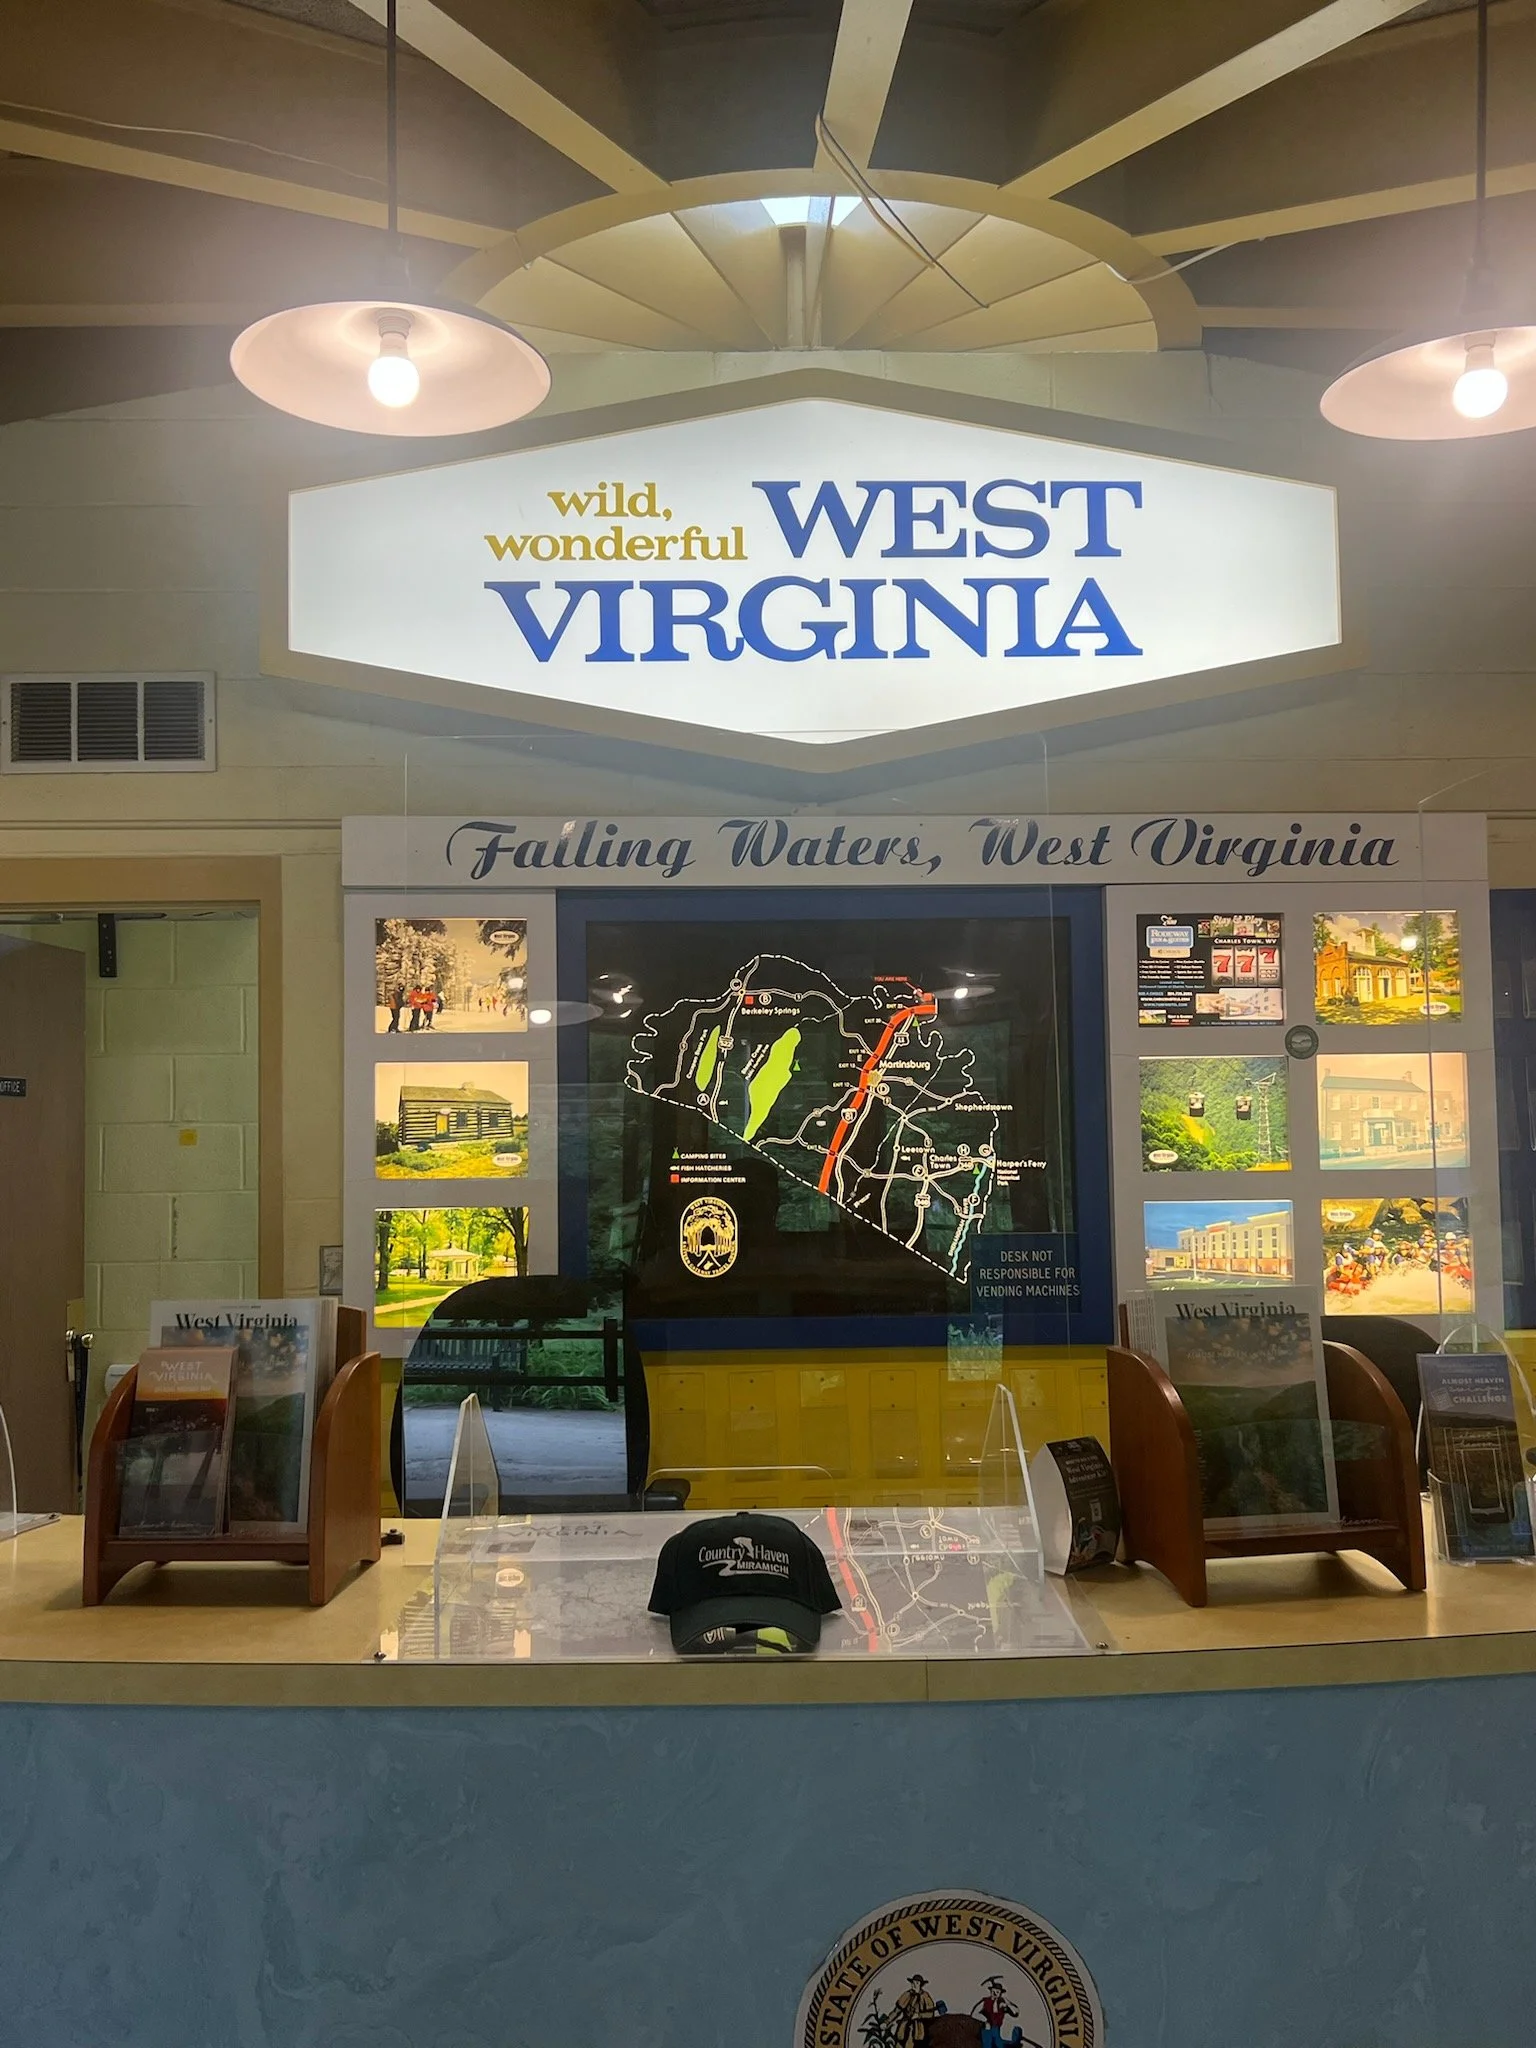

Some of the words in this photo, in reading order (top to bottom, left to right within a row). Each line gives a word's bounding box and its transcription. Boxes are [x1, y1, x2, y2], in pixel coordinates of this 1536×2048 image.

[547, 481, 673, 521] wild,
[752, 479, 1143, 559] WEST
[484, 525, 748, 561] wonderful
[484, 575, 1143, 663] VIRGINIA
[446, 819, 696, 880] Falling
[718, 819, 942, 876] Waters,
[968, 818, 1112, 866] West
[1131, 818, 1399, 876] Virginia
[1213, 915, 1232, 924] Stay
[1244, 915, 1264, 926] Play
[1260, 947, 1276, 963] 7
[1213, 955, 1231, 973] 7
[1237, 955, 1255, 973] 7
[741, 1007, 773, 1016] Berkeley
[774, 1007, 800, 1016] Springs
[879, 1060, 931, 1070] Martinsburg
[955, 1103, 1013, 1111] Shepherdstown
[929, 1154, 957, 1162] Charles
[1028, 1160, 1046, 1169] Ferry
[1001, 1251, 1028, 1262] DESK
[1032, 1250, 1053, 1261] NOT
[980, 1268, 1050, 1280] RESPONSIBLE
[1055, 1267, 1076, 1278] FOR
[976, 1285, 1022, 1297] VENDING
[1025, 1284, 1080, 1296] MACHINES
[1176, 1302, 1217, 1321] West
[1221, 1301, 1296, 1320] Virginia
[176, 1313, 220, 1330] West
[225, 1313, 297, 1331] Virginia
[161, 1361, 203, 1371] WEST
[150, 1371, 219, 1384] VIRGINIA
[1453, 1394, 1508, 1403] CHALLENGE
[699, 1546, 745, 1563] Country
[754, 1544, 789, 1564] Haven
[737, 1561, 789, 1574] MIRAMICHI
[819, 1957, 871, 2045] STATE
[871, 1928, 904, 1958] OF
[911, 1914, 1005, 1942] WEST
[1010, 1931, 1080, 2048] VIRGINI
